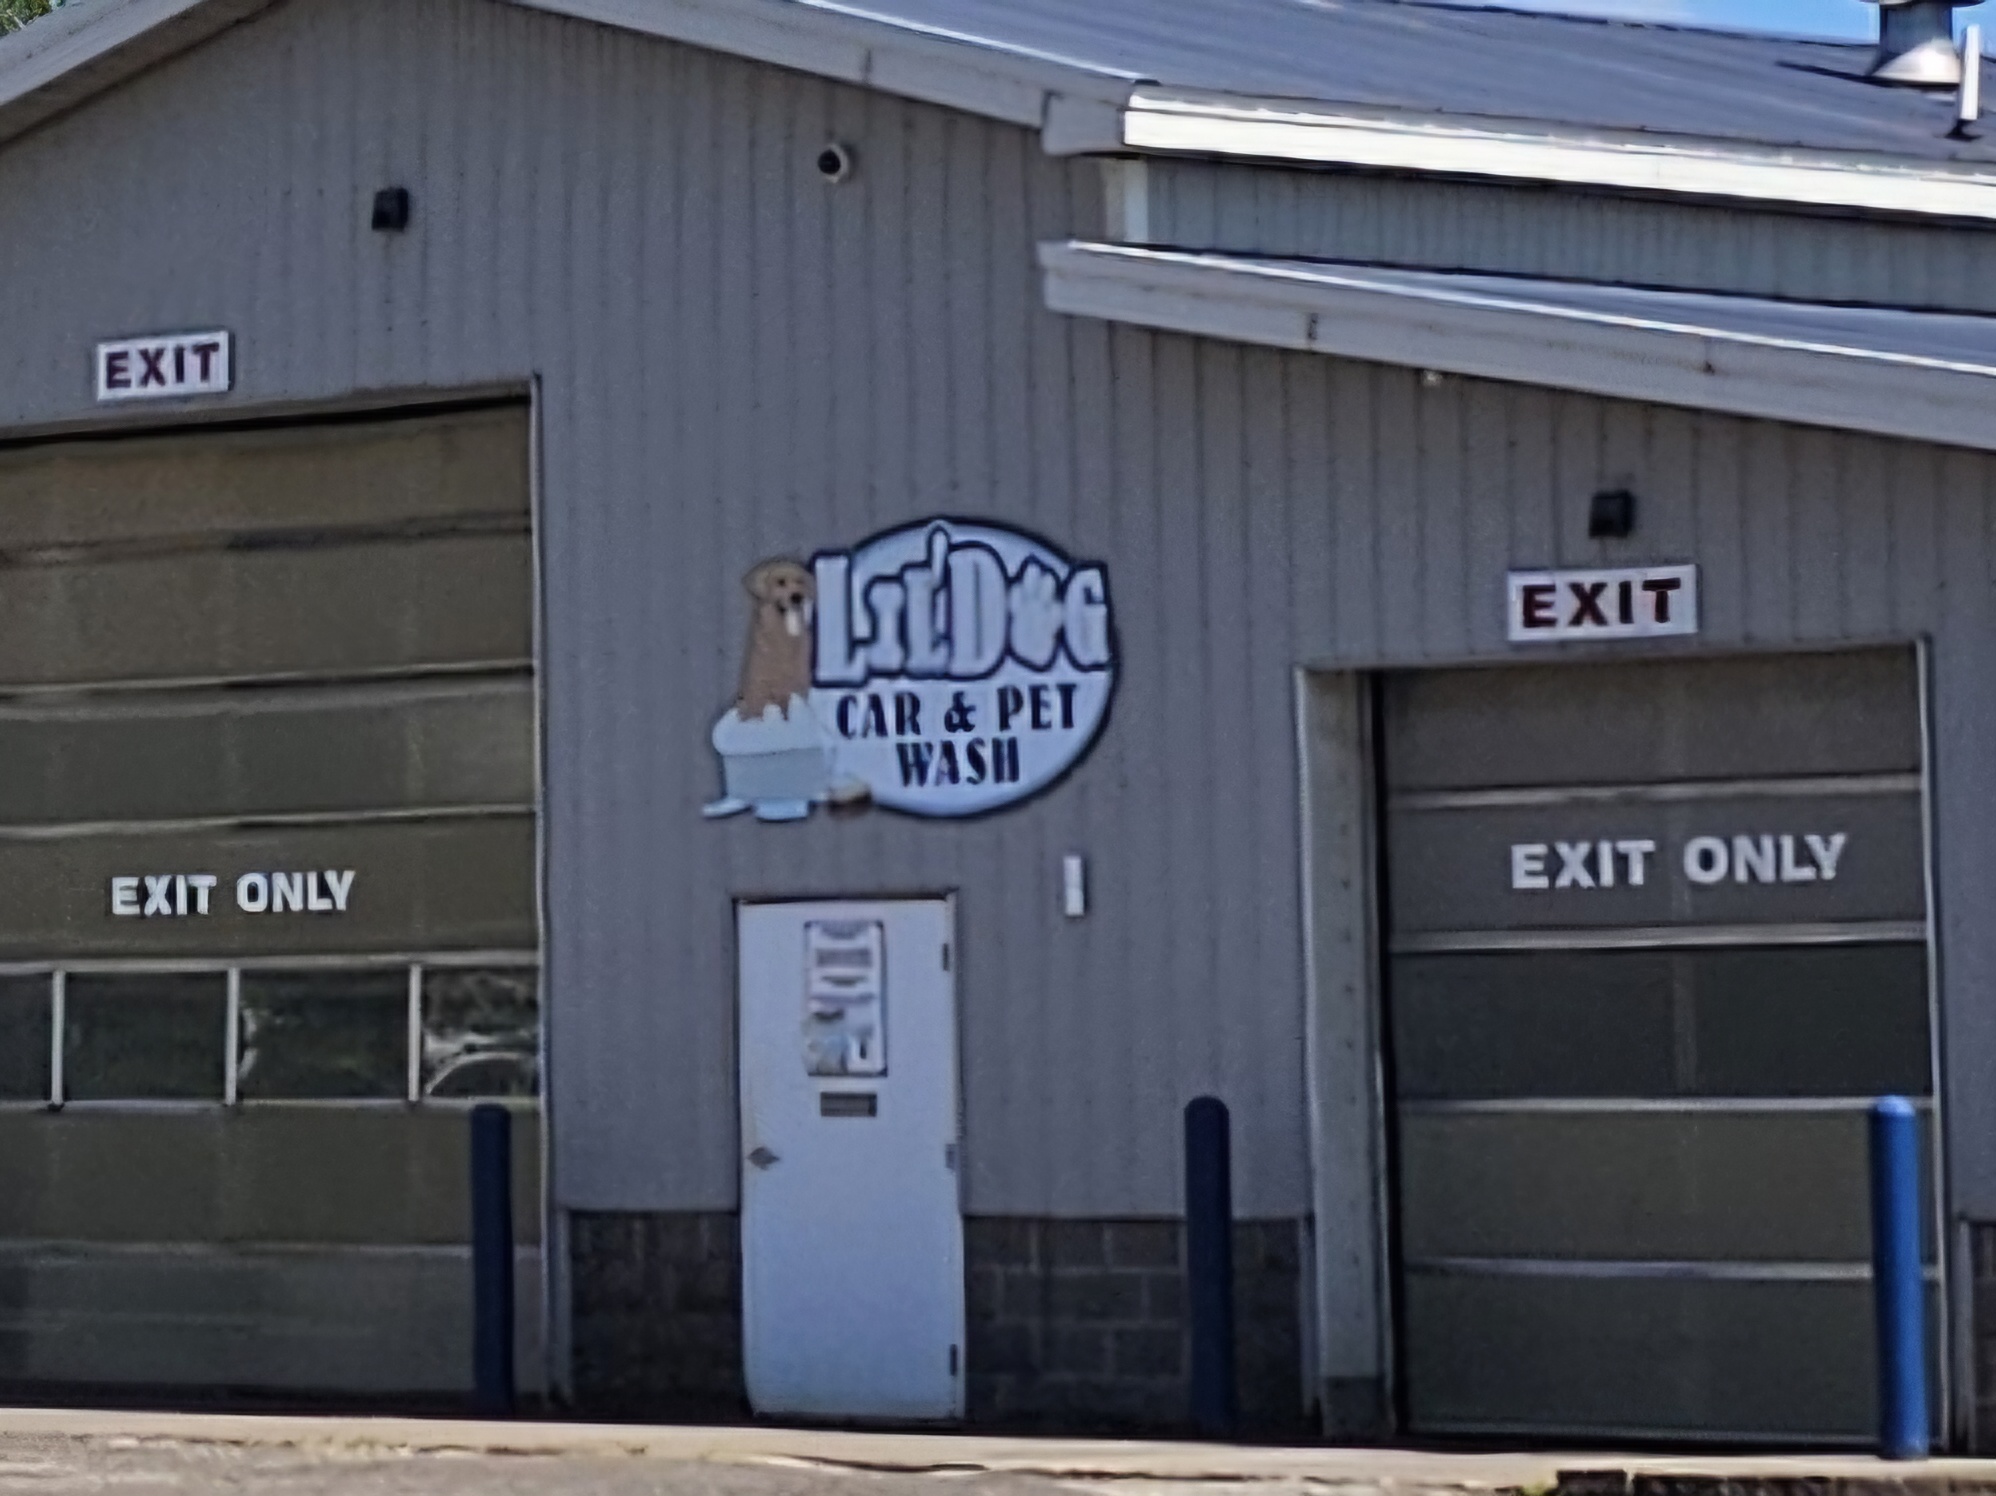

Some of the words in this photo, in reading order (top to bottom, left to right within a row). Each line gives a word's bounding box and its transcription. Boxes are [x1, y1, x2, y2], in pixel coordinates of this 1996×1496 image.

[105, 341, 220, 390] EXIT
[1522, 576, 1682, 629] EXIT
[836, 690, 922, 740] CAR
[943, 690, 977, 733] &
[996, 682, 1078, 732] PET
[895, 736, 1020, 788] WASH
[1510, 838, 1656, 890] EXIT
[1682, 831, 1848, 885] ONLY
[111, 873, 218, 917] EXIT
[236, 869, 357, 914] ONLY
